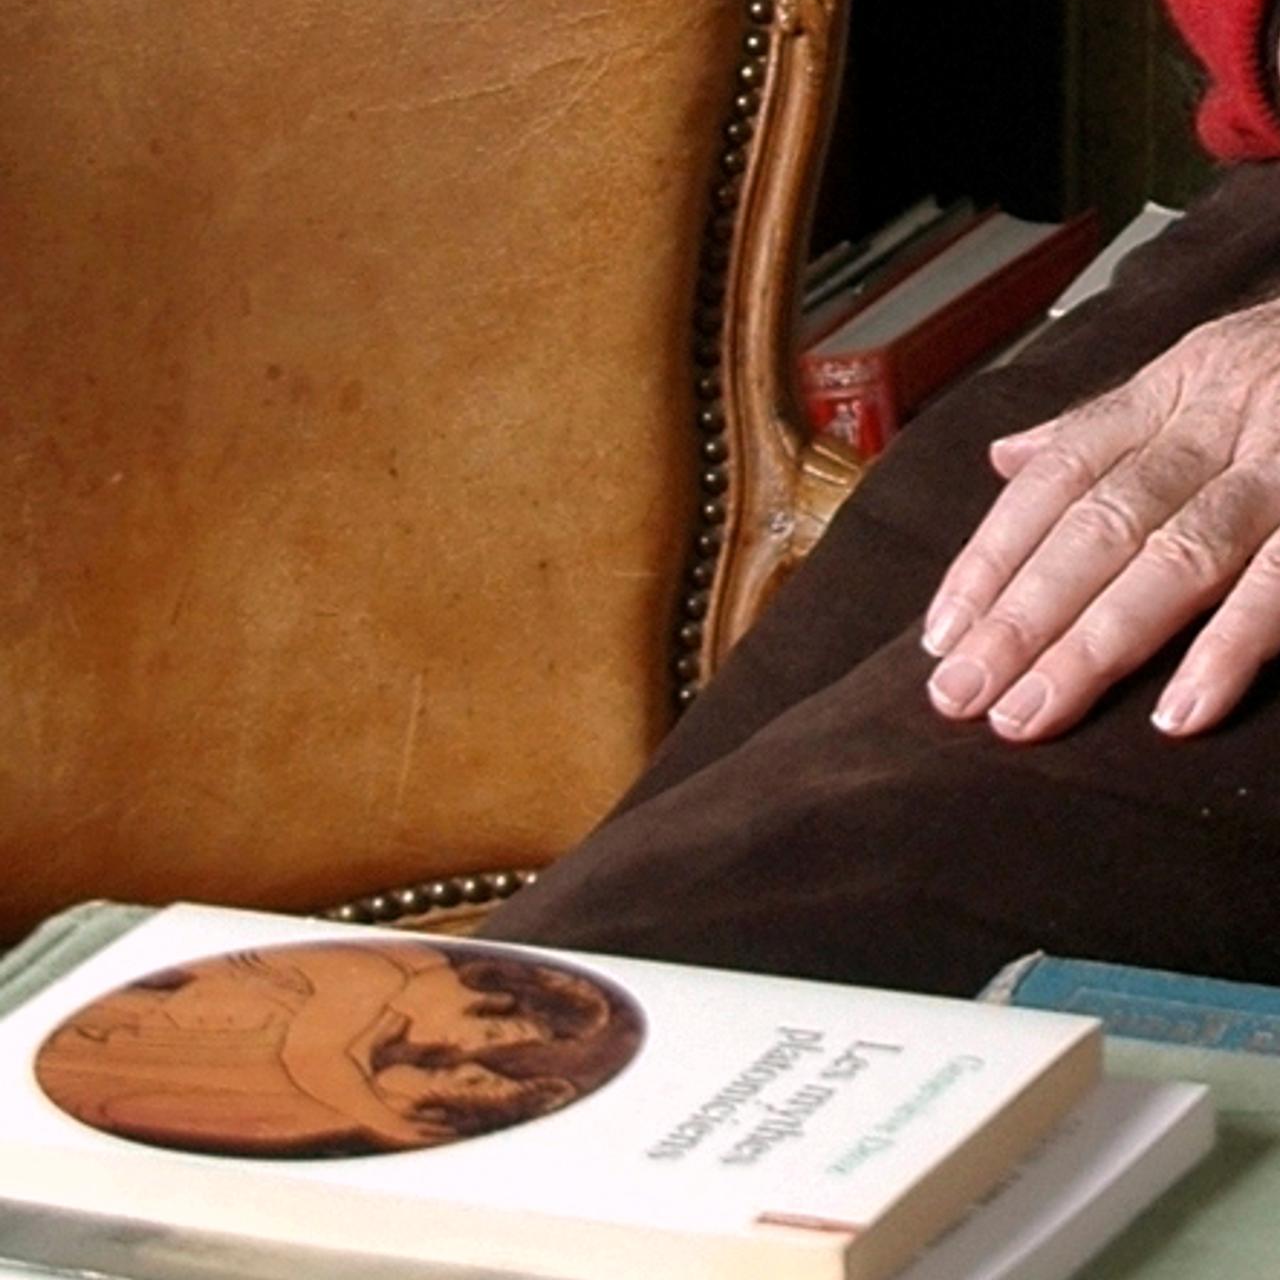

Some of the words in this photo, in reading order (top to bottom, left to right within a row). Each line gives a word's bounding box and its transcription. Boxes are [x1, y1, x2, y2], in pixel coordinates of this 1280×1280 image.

[646, 1025, 824, 1162] platoniciens
[820, 1039, 903, 1081] Les
[720, 1082, 835, 1168] mythes
